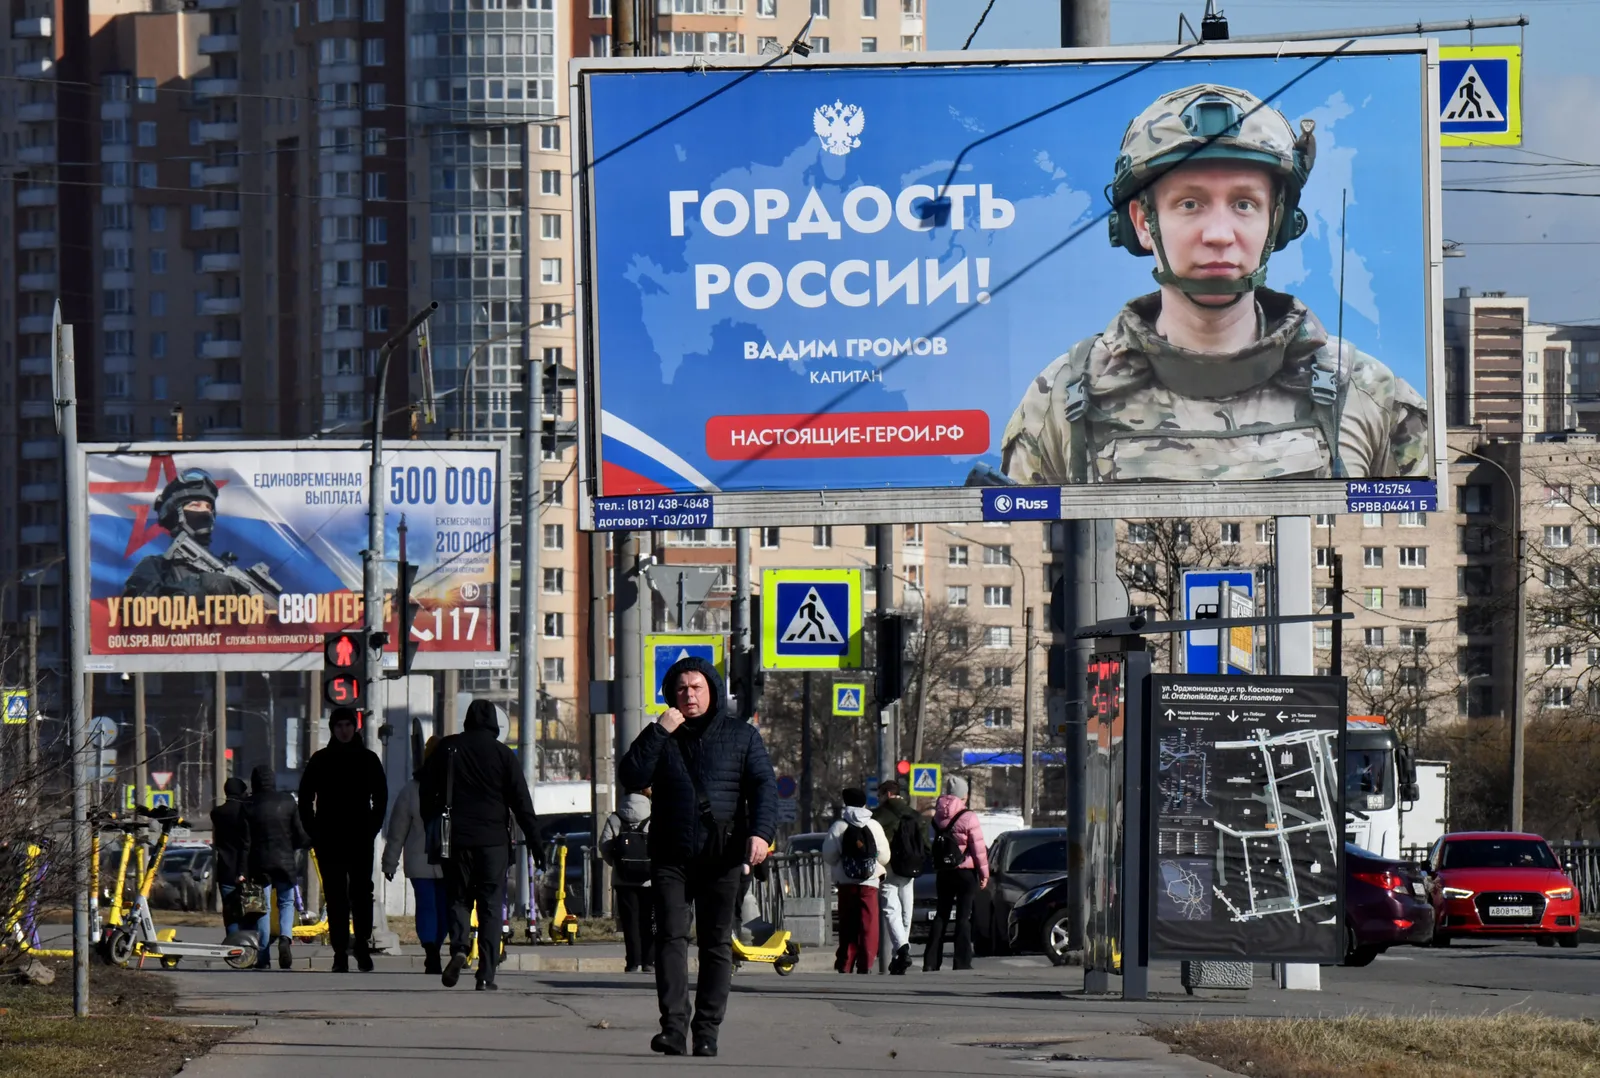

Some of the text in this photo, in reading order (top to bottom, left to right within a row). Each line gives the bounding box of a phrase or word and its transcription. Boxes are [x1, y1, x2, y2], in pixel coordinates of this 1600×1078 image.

[669, 184, 1016, 241] ГОРДОСТЬ
[695, 257, 991, 310] РОССИИ!
[744, 336, 948, 361] ВАДИМ ГРОМОВ
[810, 370, 883, 384] КАПИТАН
[731, 424, 964, 447] НАСТОЯЩИЕ-ГЕРОИ.РФ
[254, 472, 362, 488] ЕДИНОВРЕМЕННАЯ
[390, 466, 492, 505] 500 000
[1373, 483, 1412, 494] 125754
[305, 490, 362, 505] ВЫПЛАТА
[598, 498, 709, 511] тел.: (812) 438-4848
[1015, 498, 1048, 510] Russ
[483, 517, 491, 526] ОТ
[598, 517, 648, 528] договор:
[436, 531, 491, 553] 210 000
[464, 586, 477, 597] 18+
[107, 597, 120, 627] У
[278, 593, 330, 624] СВОИ
[333, 592, 392, 623] ГЕРИ
[432, 606, 479, 641] 117
[108, 633, 222, 648] GOV.SPB.RU/CONTRACT
[225, 635, 256, 645] СЛУЖБА
[257, 635, 266, 645] ПО
[268, 634, 308, 644] КОНТРАКТУ
[333, 678, 358, 700] 51
[1161, 685, 1172, 693] ул.
[1236, 687, 1247, 695] пр.
[1248, 685, 1294, 694] Космонавтов
[1239, 693, 1283, 702] Kosmonavtov
